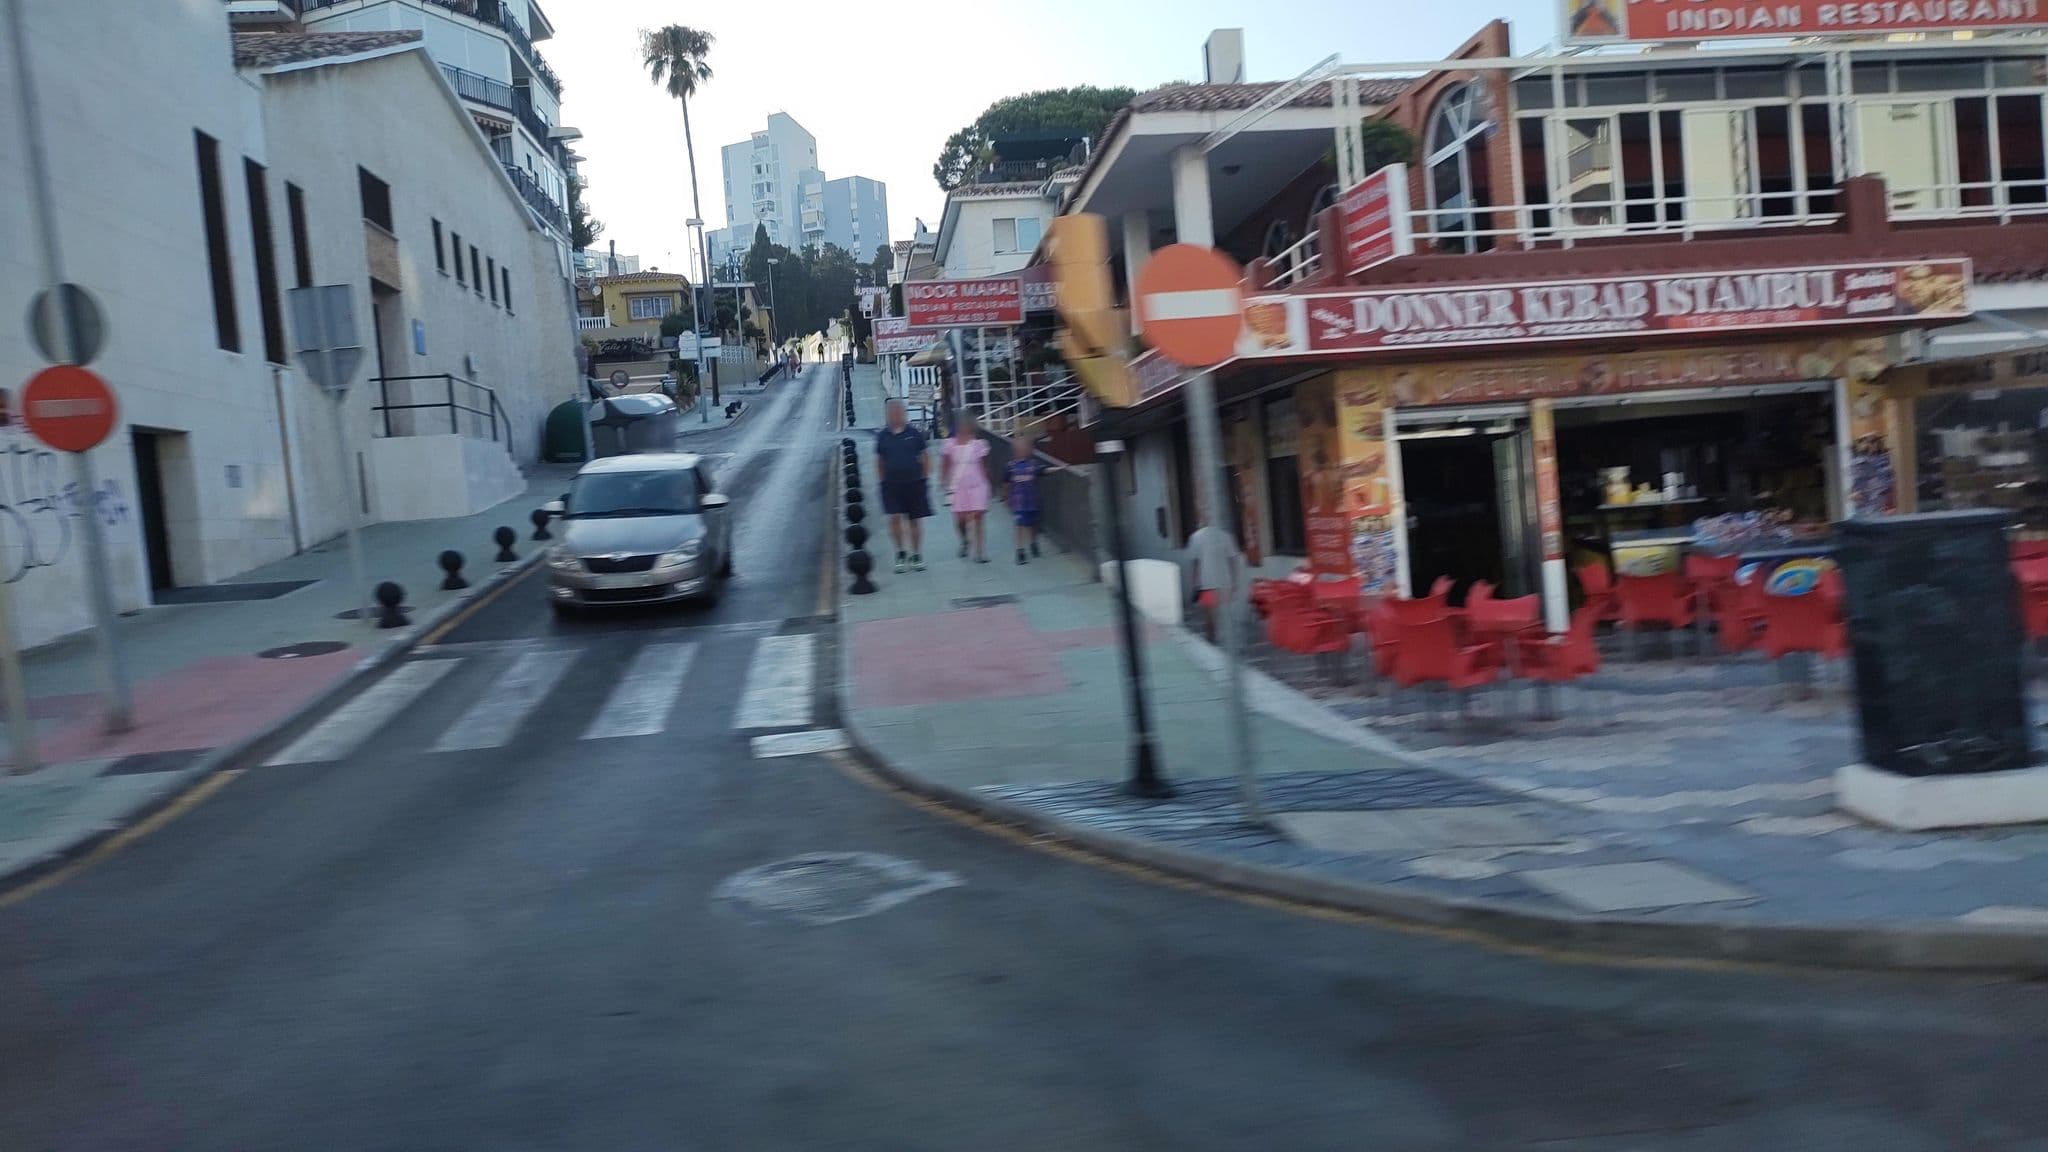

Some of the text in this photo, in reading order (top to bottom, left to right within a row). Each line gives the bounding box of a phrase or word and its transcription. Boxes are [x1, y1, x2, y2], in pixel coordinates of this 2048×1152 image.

[1667, 0, 2038, 32] INDIAN RESTAURANT
[909, 281, 1019, 299] NOOR MAHAL
[1352, 290, 1517, 333] DONNER
[1519, 282, 1650, 322] KEBAB
[1654, 271, 1846, 316] ISTAMBUL
[911, 299, 1019, 313] INDIAN RESTAURANT
